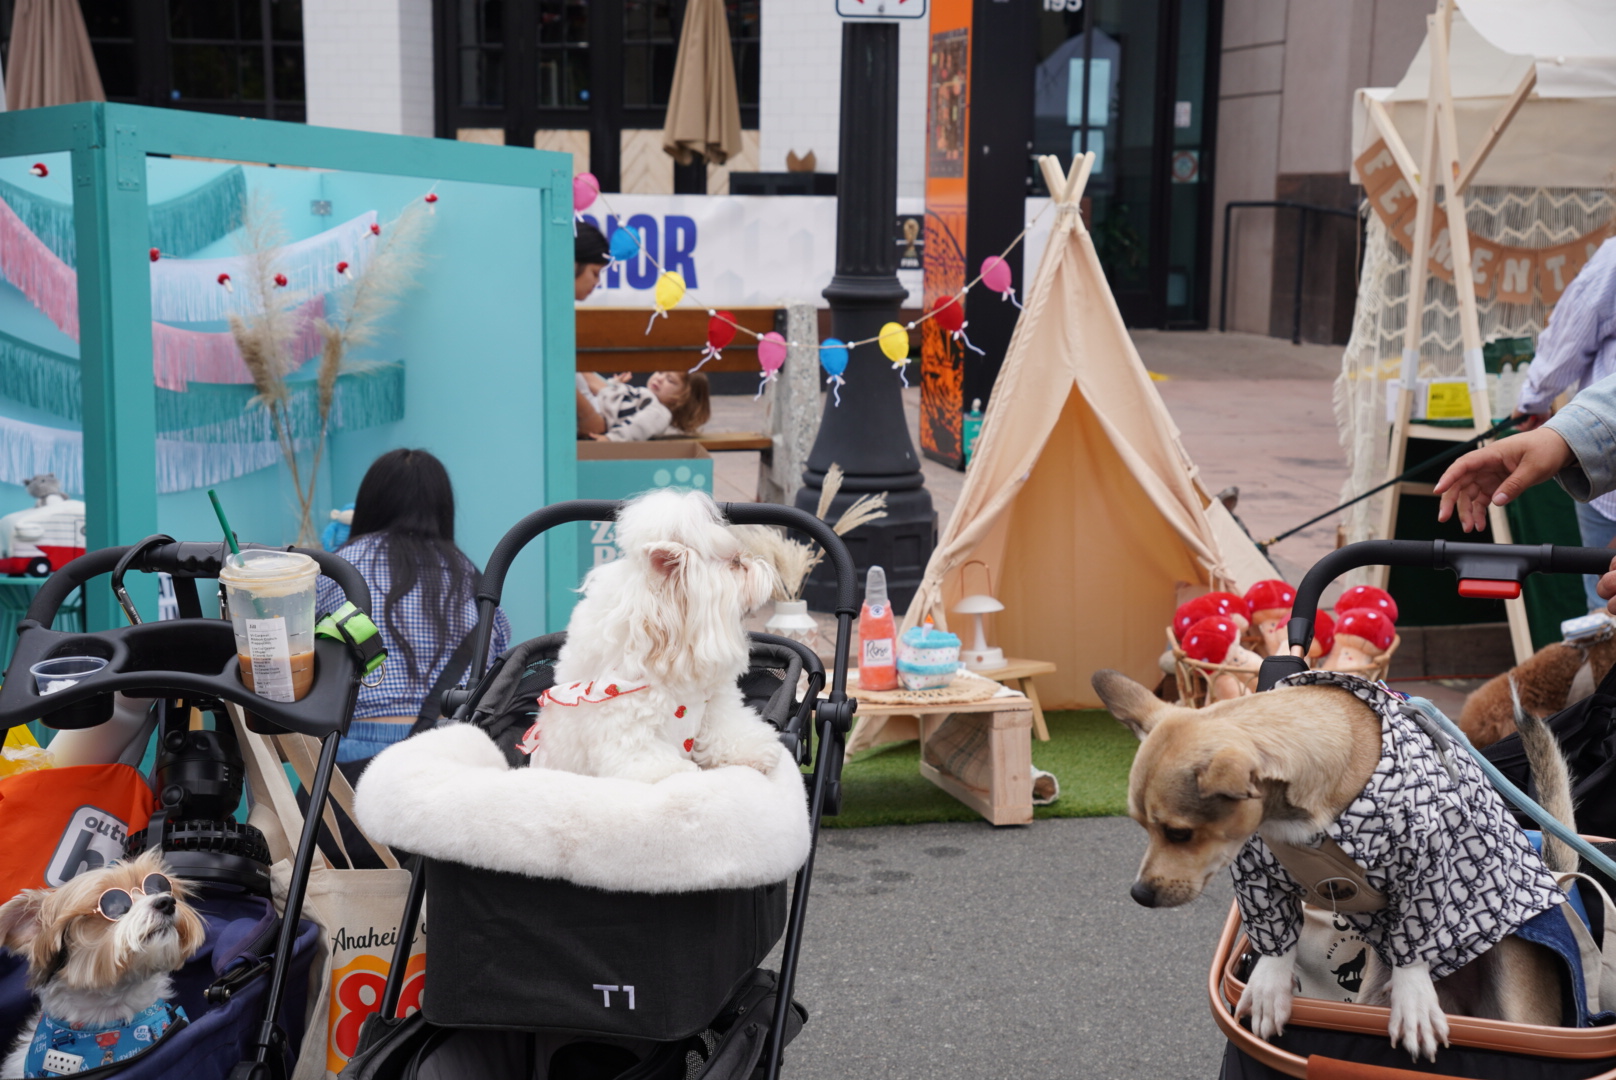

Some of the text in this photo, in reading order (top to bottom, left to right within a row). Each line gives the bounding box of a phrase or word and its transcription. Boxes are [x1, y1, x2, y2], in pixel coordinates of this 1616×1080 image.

[331, 926, 418, 957] Anahei
[1326, 942, 1339, 960] WILD
[592, 983, 635, 1010] T1
